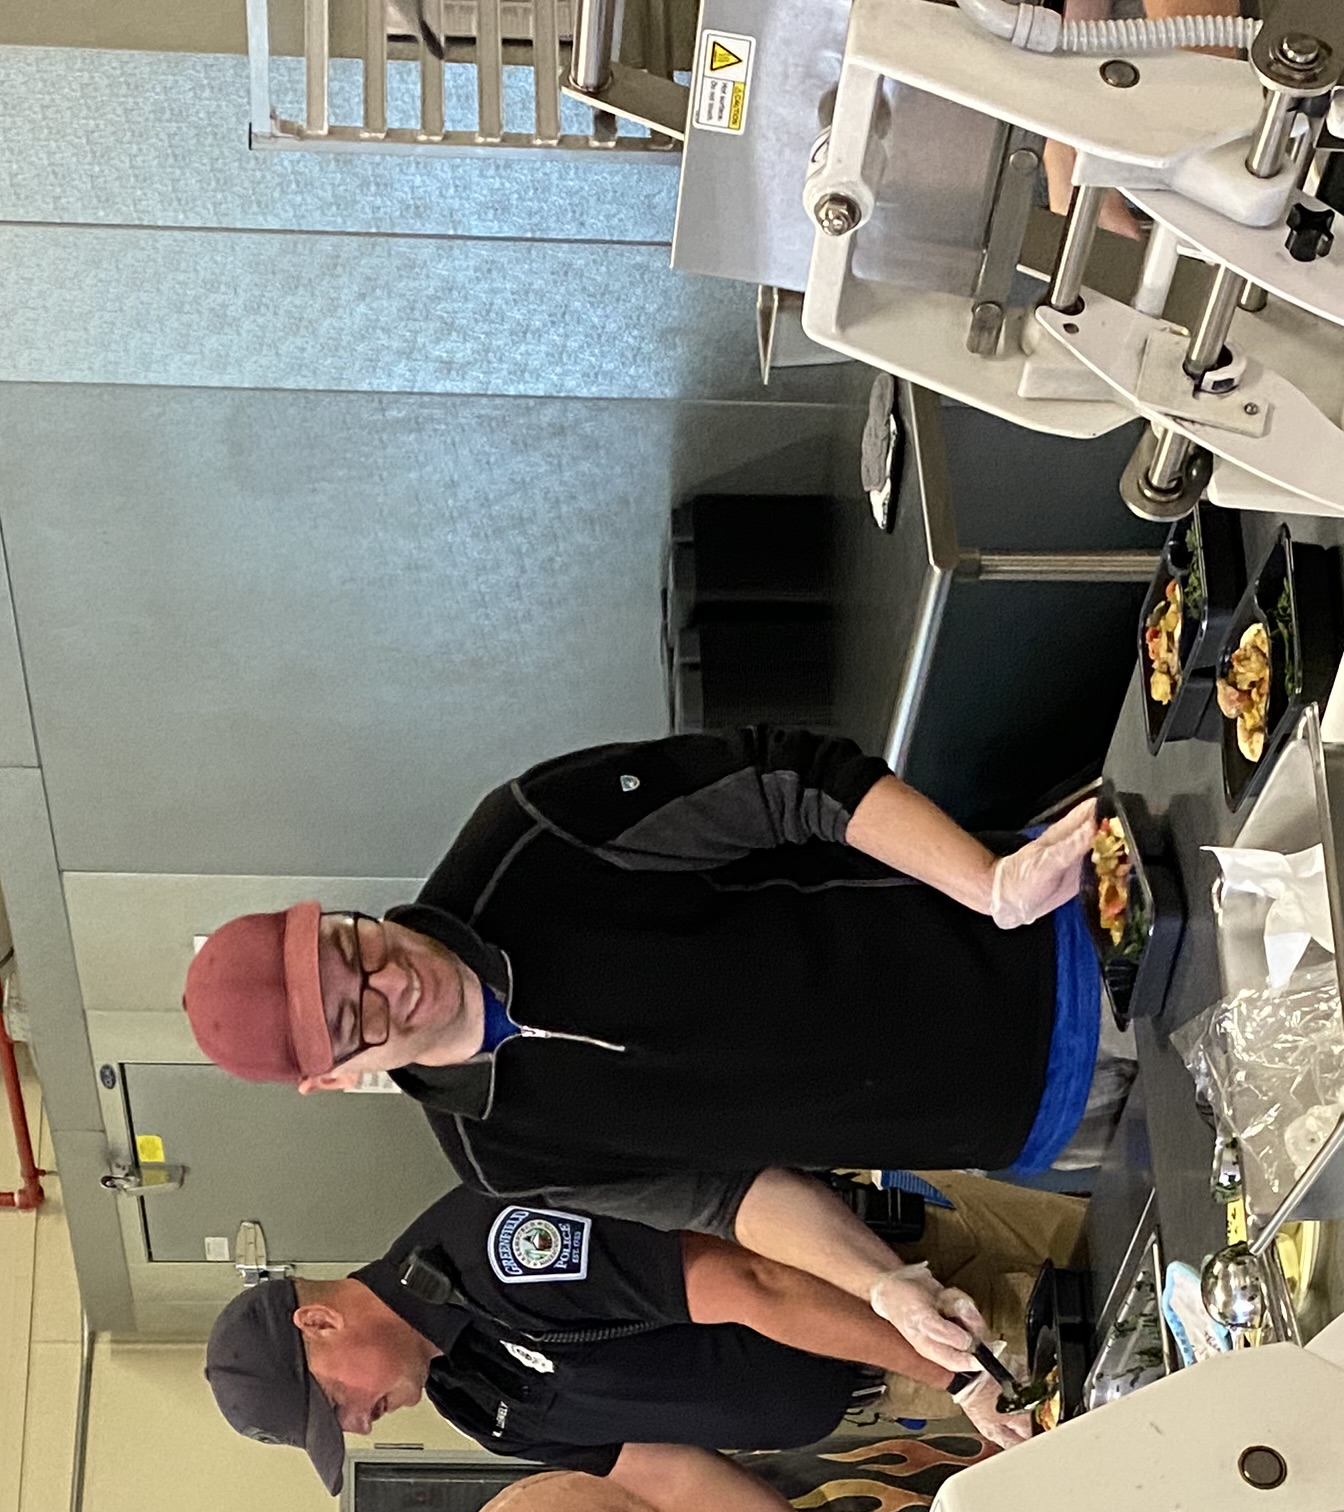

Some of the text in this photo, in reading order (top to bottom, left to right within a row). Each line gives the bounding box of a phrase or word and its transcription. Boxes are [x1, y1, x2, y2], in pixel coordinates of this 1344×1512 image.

[732, 94, 742, 125] CAUTION
[498, 1210, 530, 1275] GREENFIELD
[553, 1222, 572, 1269] POLICE
